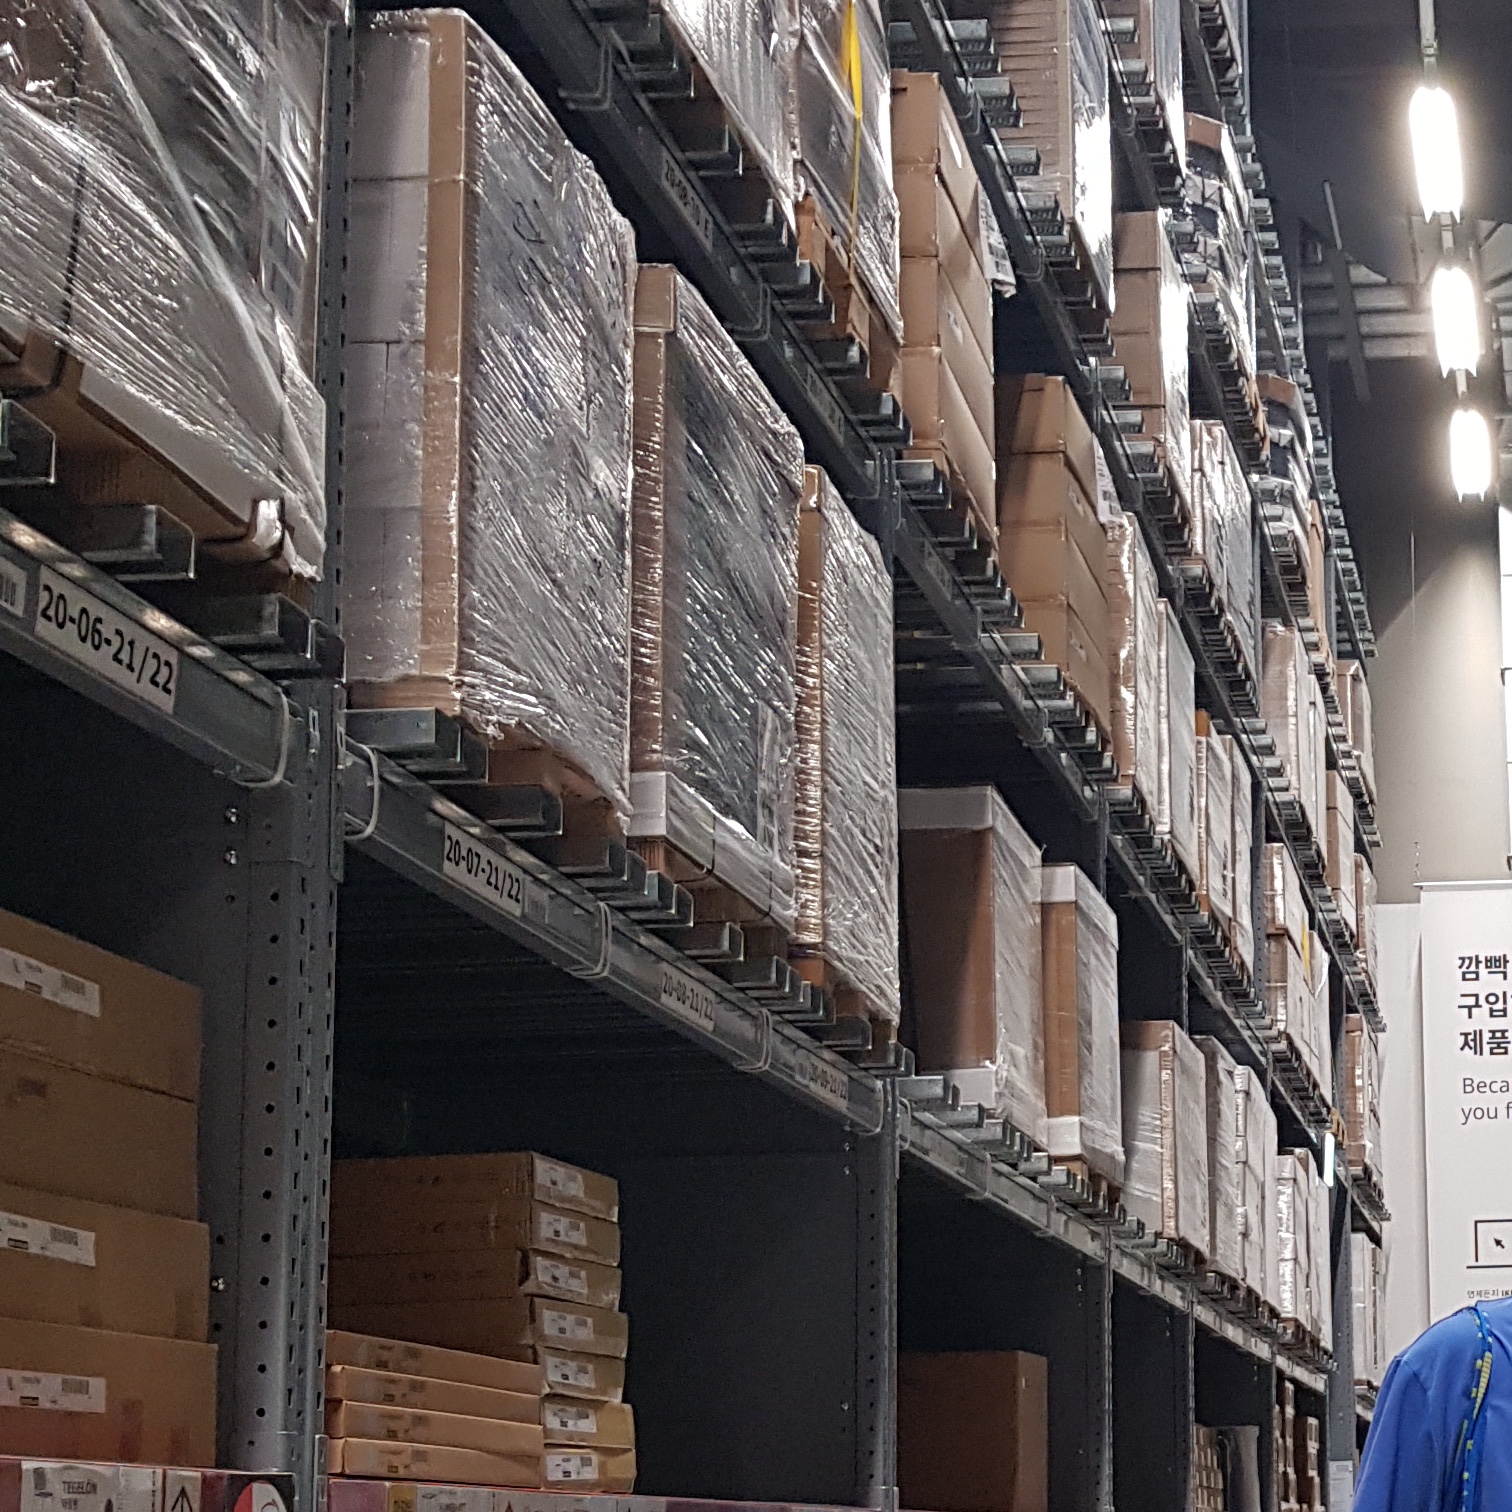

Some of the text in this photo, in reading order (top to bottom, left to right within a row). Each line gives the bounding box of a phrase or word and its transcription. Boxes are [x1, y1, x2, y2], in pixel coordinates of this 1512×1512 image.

[40, 584, 173, 696] 20-06-21/22
[446, 835, 521, 904] 20-07-21/22
[1457, 953, 1510, 982] 깜빡
[1460, 1106, 1498, 1126] you
